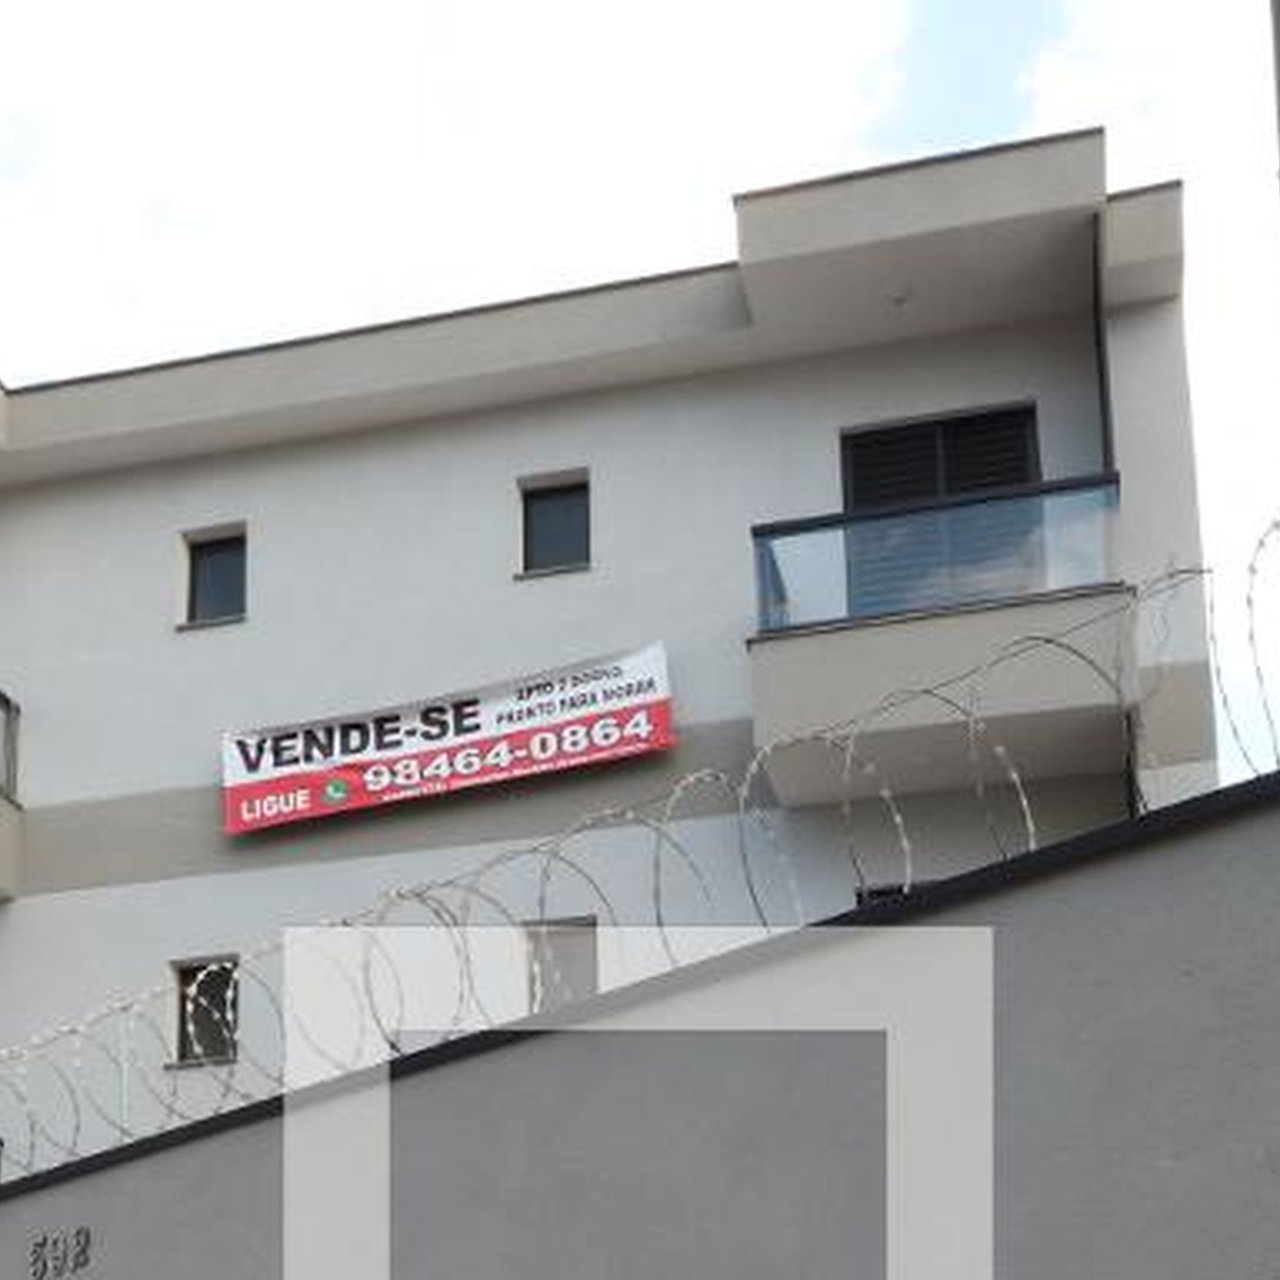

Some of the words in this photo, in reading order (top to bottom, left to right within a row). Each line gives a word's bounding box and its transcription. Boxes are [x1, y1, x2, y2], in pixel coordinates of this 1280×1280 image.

[237, 698, 482, 774] VENDE-SE
[559, 692, 599, 711] PARA
[241, 788, 311, 822] LIGUE
[363, 708, 654, 793] 98464-0864
